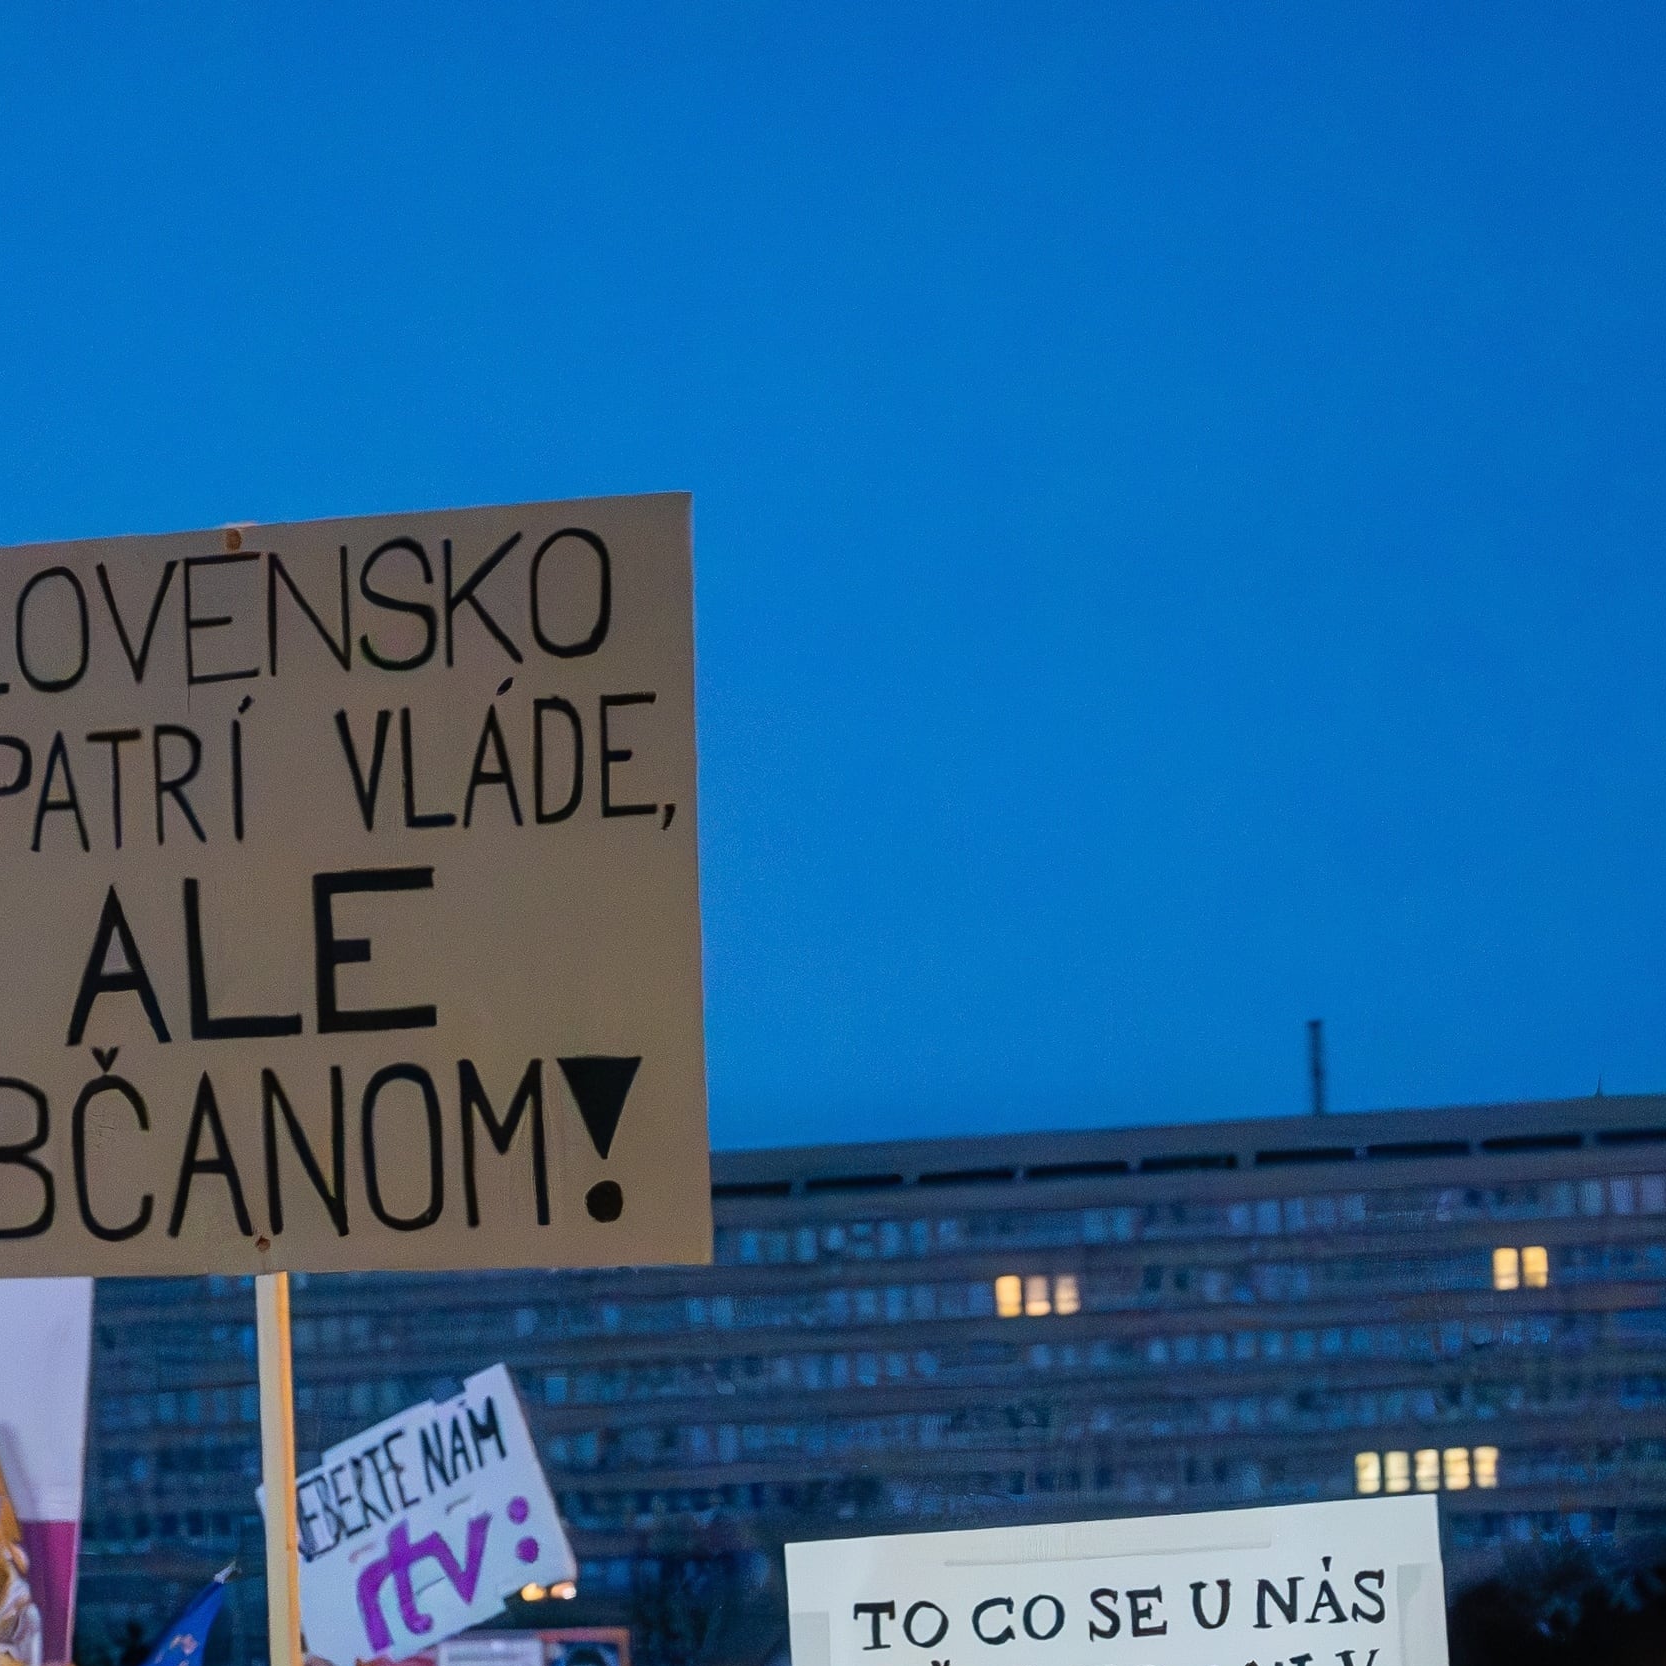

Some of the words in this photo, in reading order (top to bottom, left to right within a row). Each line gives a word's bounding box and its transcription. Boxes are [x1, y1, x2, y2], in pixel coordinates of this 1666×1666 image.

[336, 678, 677, 834] VLÁDE,
[67, 866, 438, 1046] ALE
[297, 1428, 421, 1563] EBERTE
[853, 1600, 949, 1651] TO
[971, 1594, 1065, 1646] CO
[1088, 1585, 1169, 1642] SE
[1190, 1578, 1231, 1630] U
[1253, 1556, 1387, 1629] NÁS
